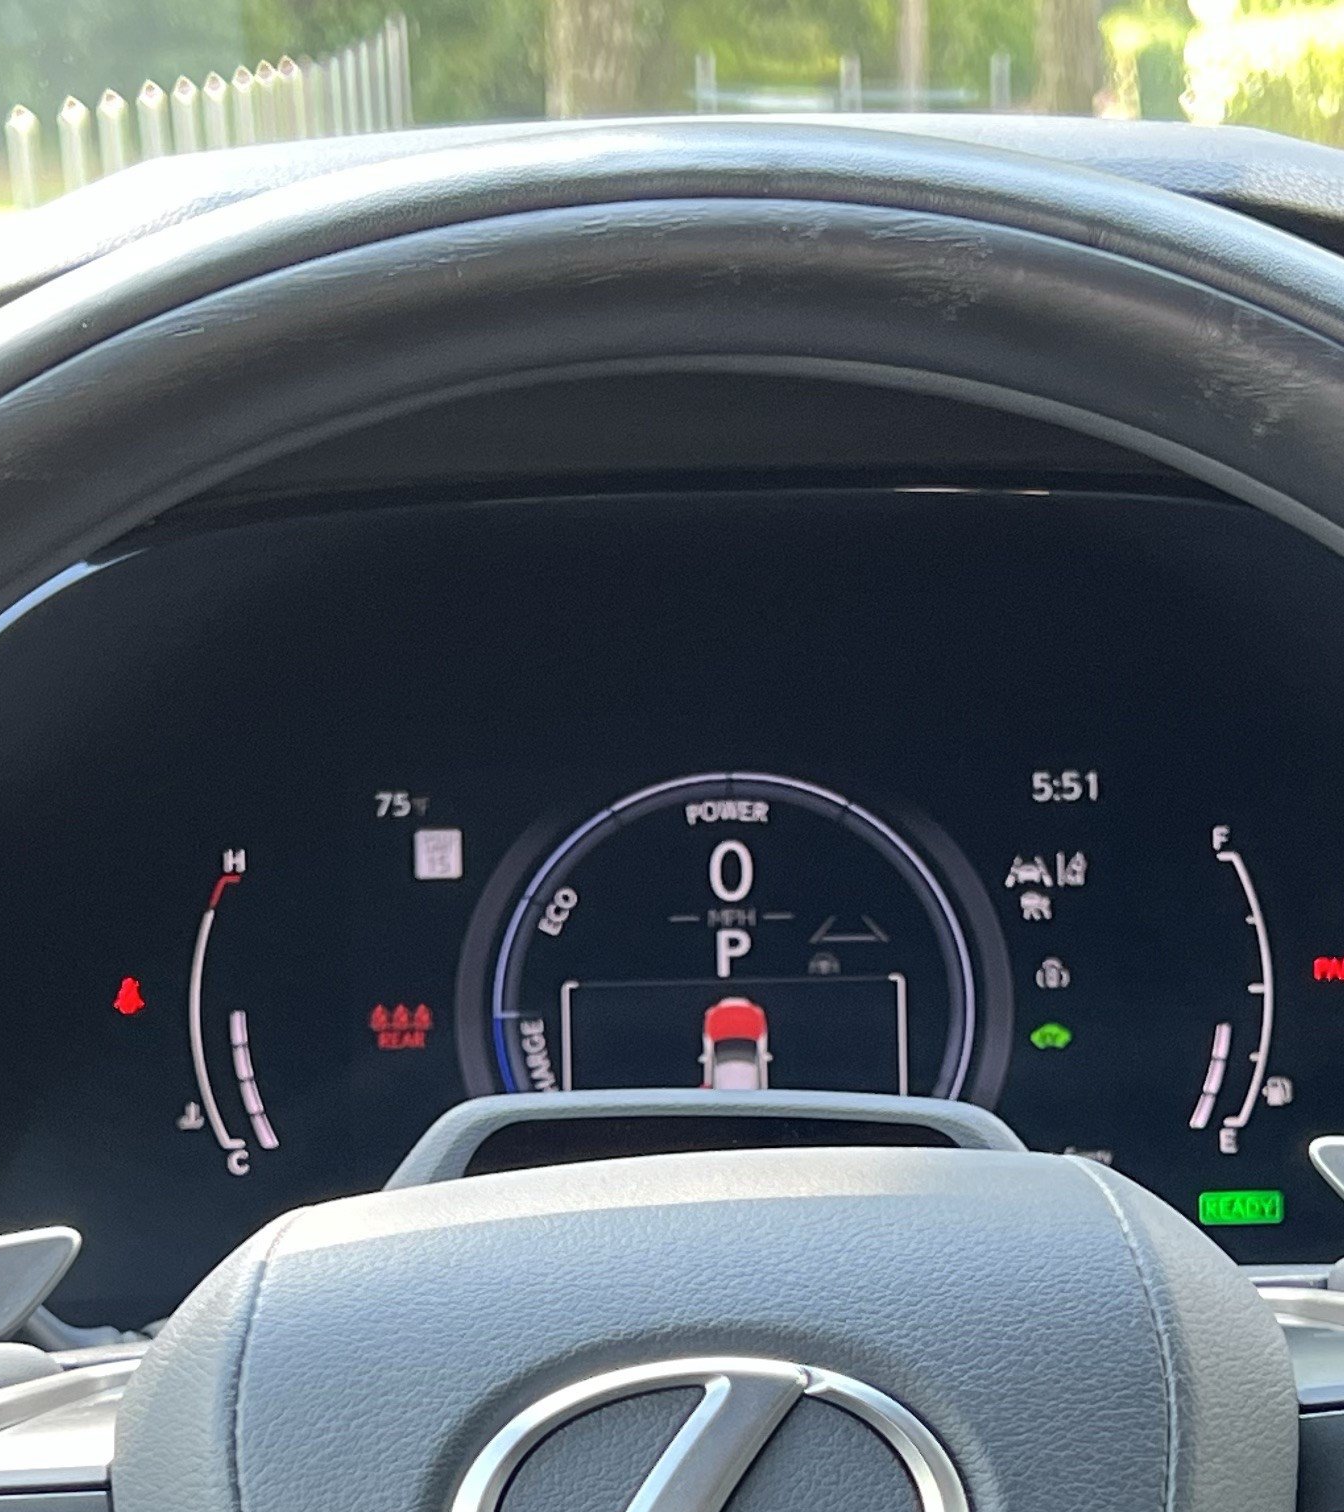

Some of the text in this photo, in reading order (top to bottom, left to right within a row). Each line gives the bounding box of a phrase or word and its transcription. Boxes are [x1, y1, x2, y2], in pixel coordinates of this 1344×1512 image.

[1032, 771, 1099, 801] 5:51
[685, 800, 770, 826] POWER
[1212, 825, 1230, 850] F
[223, 848, 246, 873] H
[709, 839, 754, 902] 0
[538, 886, 579, 936] ECO
[715, 927, 752, 978] P
[377, 1030, 426, 1050] REAR
[1219, 1128, 1238, 1154] E
[226, 1150, 250, 1176] C
[1203, 1198, 1277, 1218] READY
